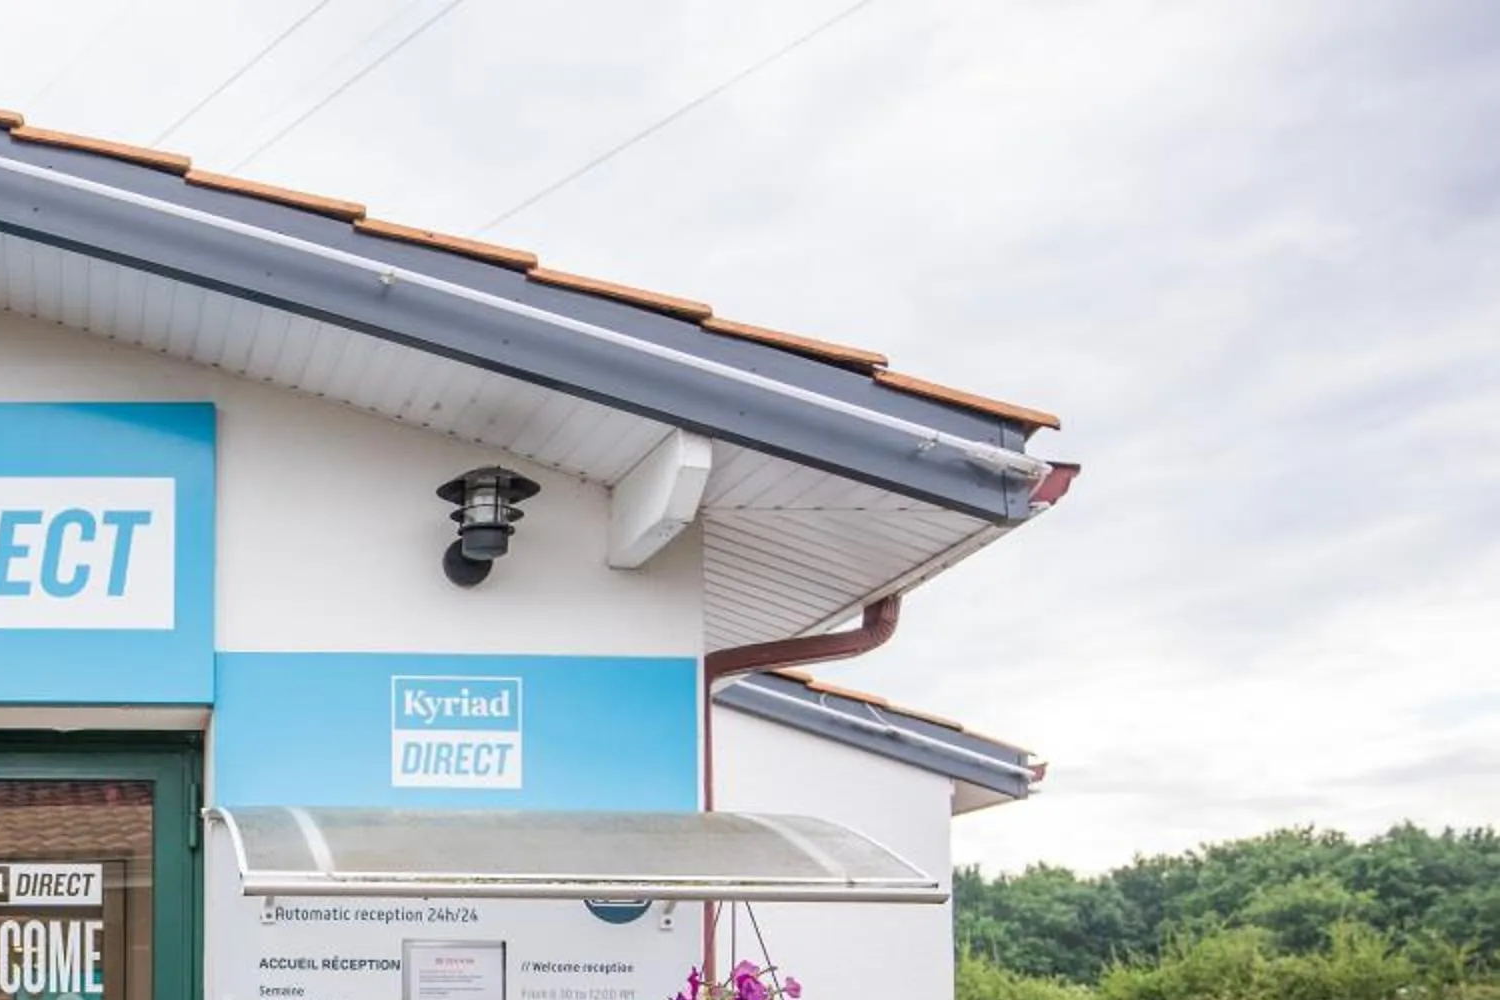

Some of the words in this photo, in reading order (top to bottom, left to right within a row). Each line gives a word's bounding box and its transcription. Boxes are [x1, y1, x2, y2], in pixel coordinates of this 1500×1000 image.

[403, 688, 510, 725] Kyriad
[401, 741, 514, 776] DIRECT
[15, 873, 95, 897] DIRECT
[275, 906, 351, 922] Automatic
[354, 907, 423, 926] reception
[426, 906, 479, 923] 24h/24
[259, 958, 318, 970] ACCUEIL
[322, 955, 401, 971] RÉCEPTION
[533, 961, 580, 973] Welcome
[583, 961, 634, 975] reception
[259, 985, 305, 997] Semaine
